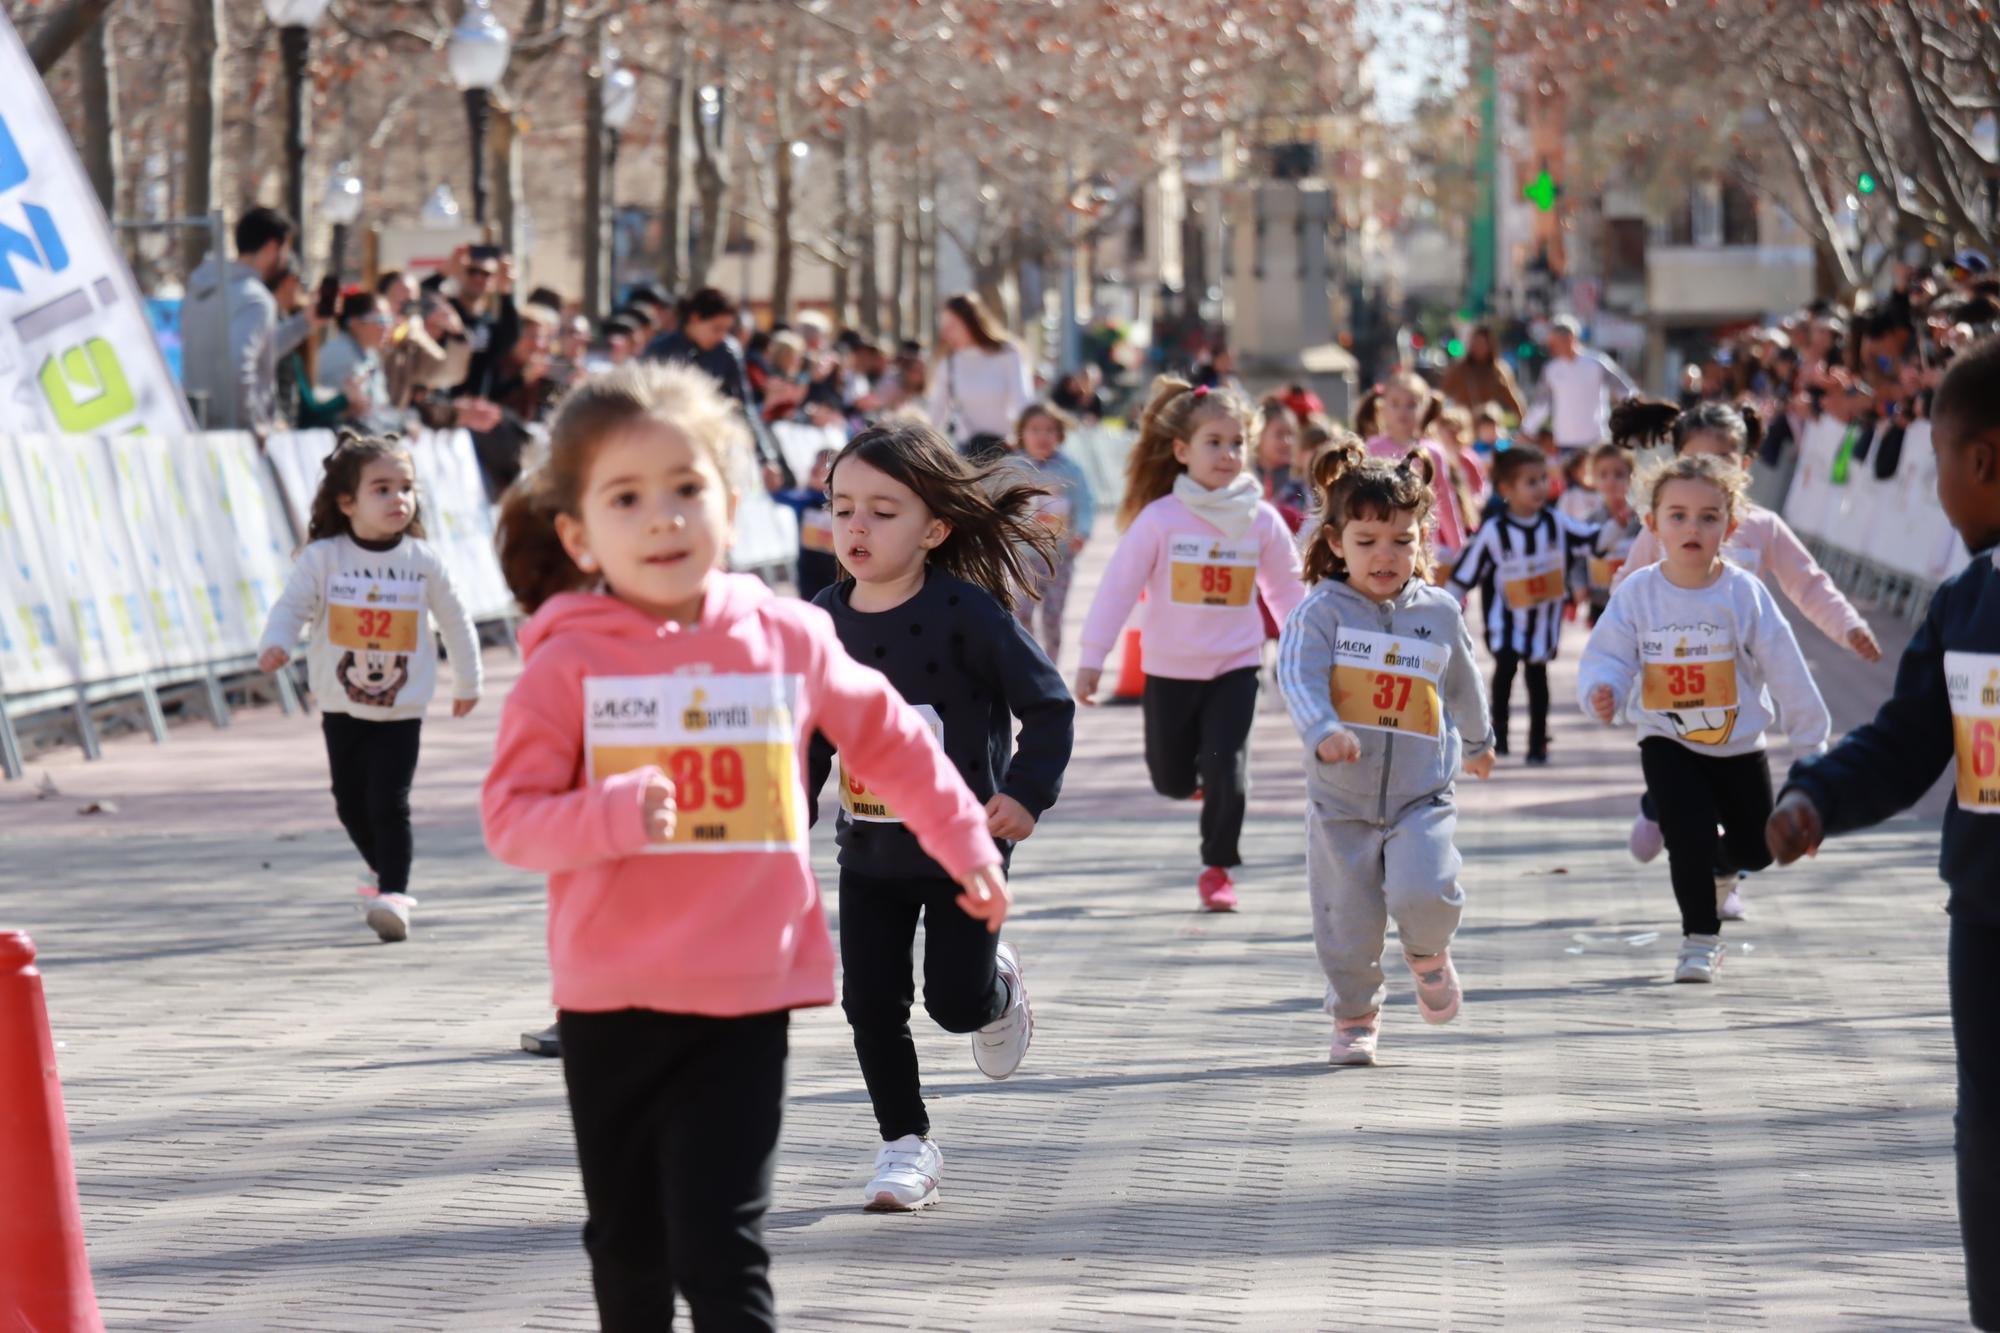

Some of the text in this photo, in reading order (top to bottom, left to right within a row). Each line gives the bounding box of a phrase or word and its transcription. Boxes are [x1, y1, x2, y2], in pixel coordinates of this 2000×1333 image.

[1201, 565, 1232, 593] 85
[358, 608, 392, 638] 32
[1384, 652, 1420, 669] marató
[1373, 672, 1412, 713] 37
[1666, 665, 1705, 696] 35
[1378, 715, 1399, 728] LOLA
[1972, 720, 2000, 778] 6
[669, 746, 746, 812] 89
[853, 802, 886, 815] MARINA
